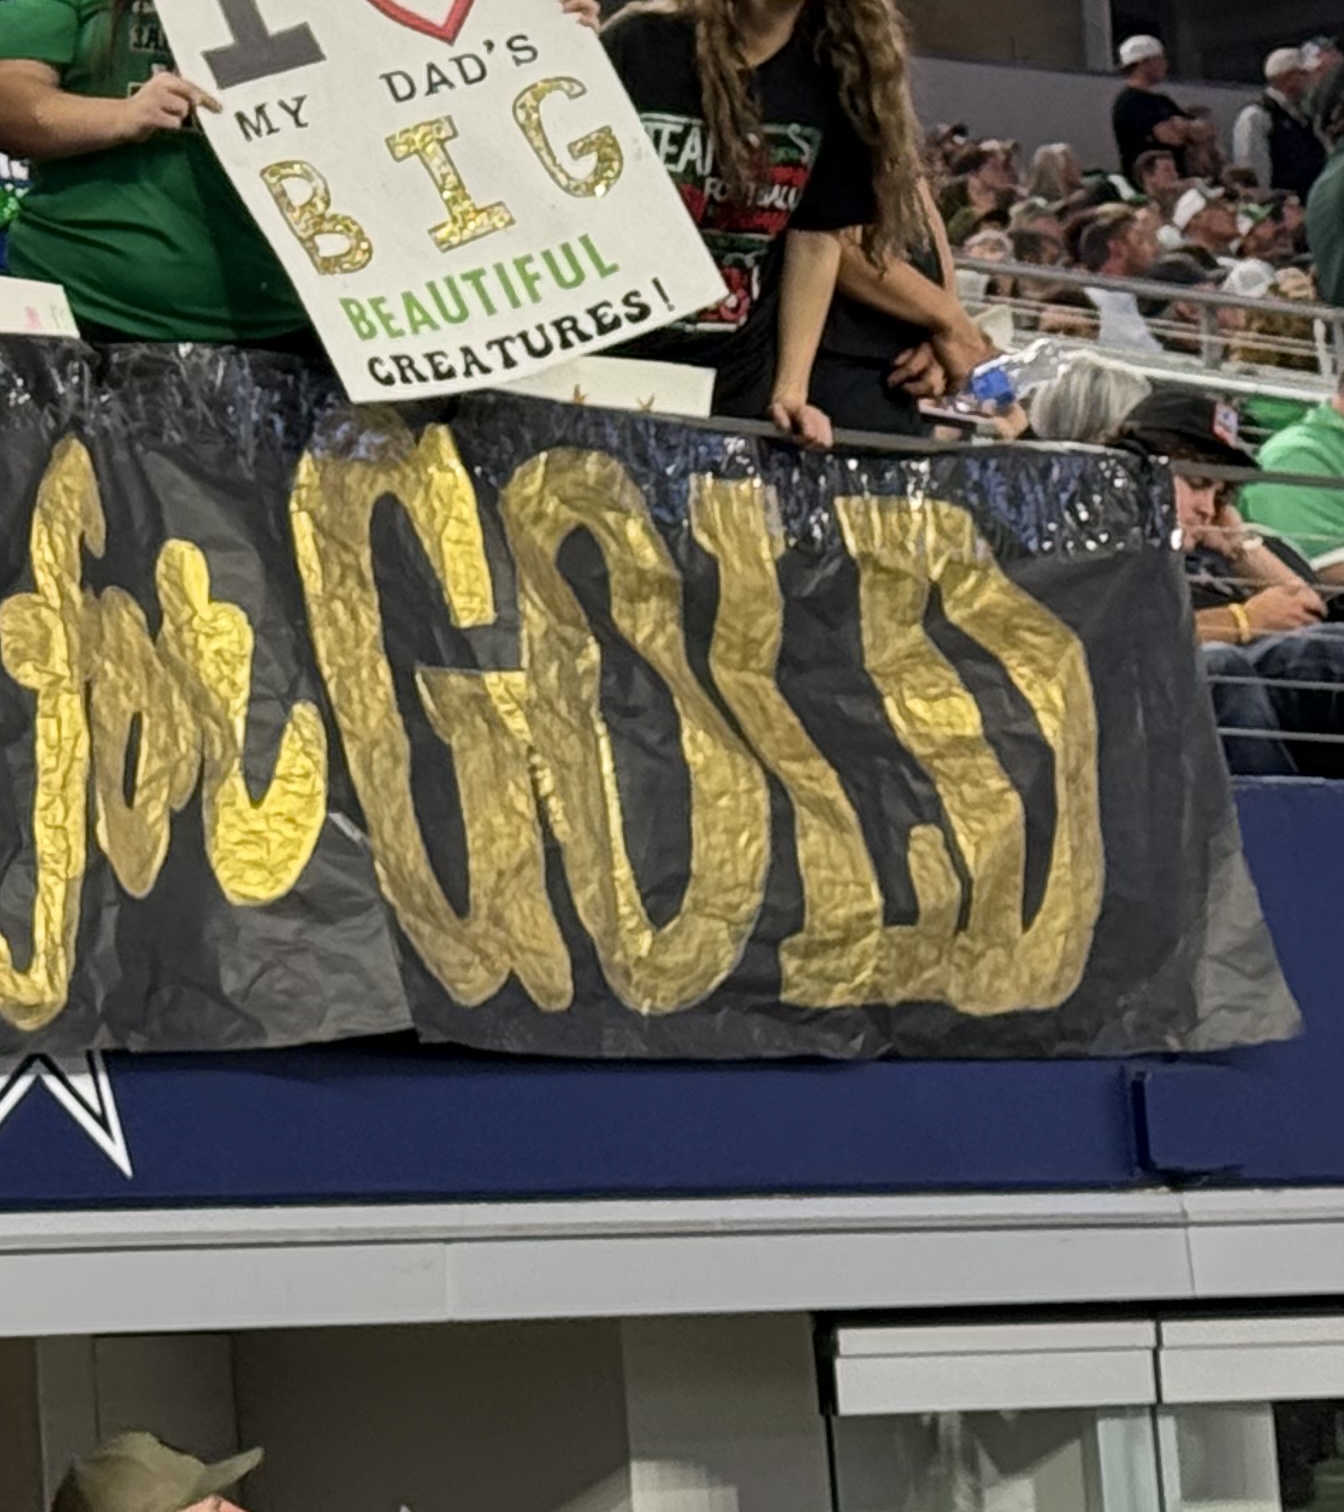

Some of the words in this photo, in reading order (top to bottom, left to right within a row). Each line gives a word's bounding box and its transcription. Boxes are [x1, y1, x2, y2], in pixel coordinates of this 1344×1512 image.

[232, 94, 311, 143] MY
[378, 33, 540, 104] DAD'S
[258, 75, 625, 277] BIG
[338, 232, 621, 342] BEAUTIFUL
[366, 276, 676, 387] CREATURES!
[289, 423, 1102, 1016] GOLD
